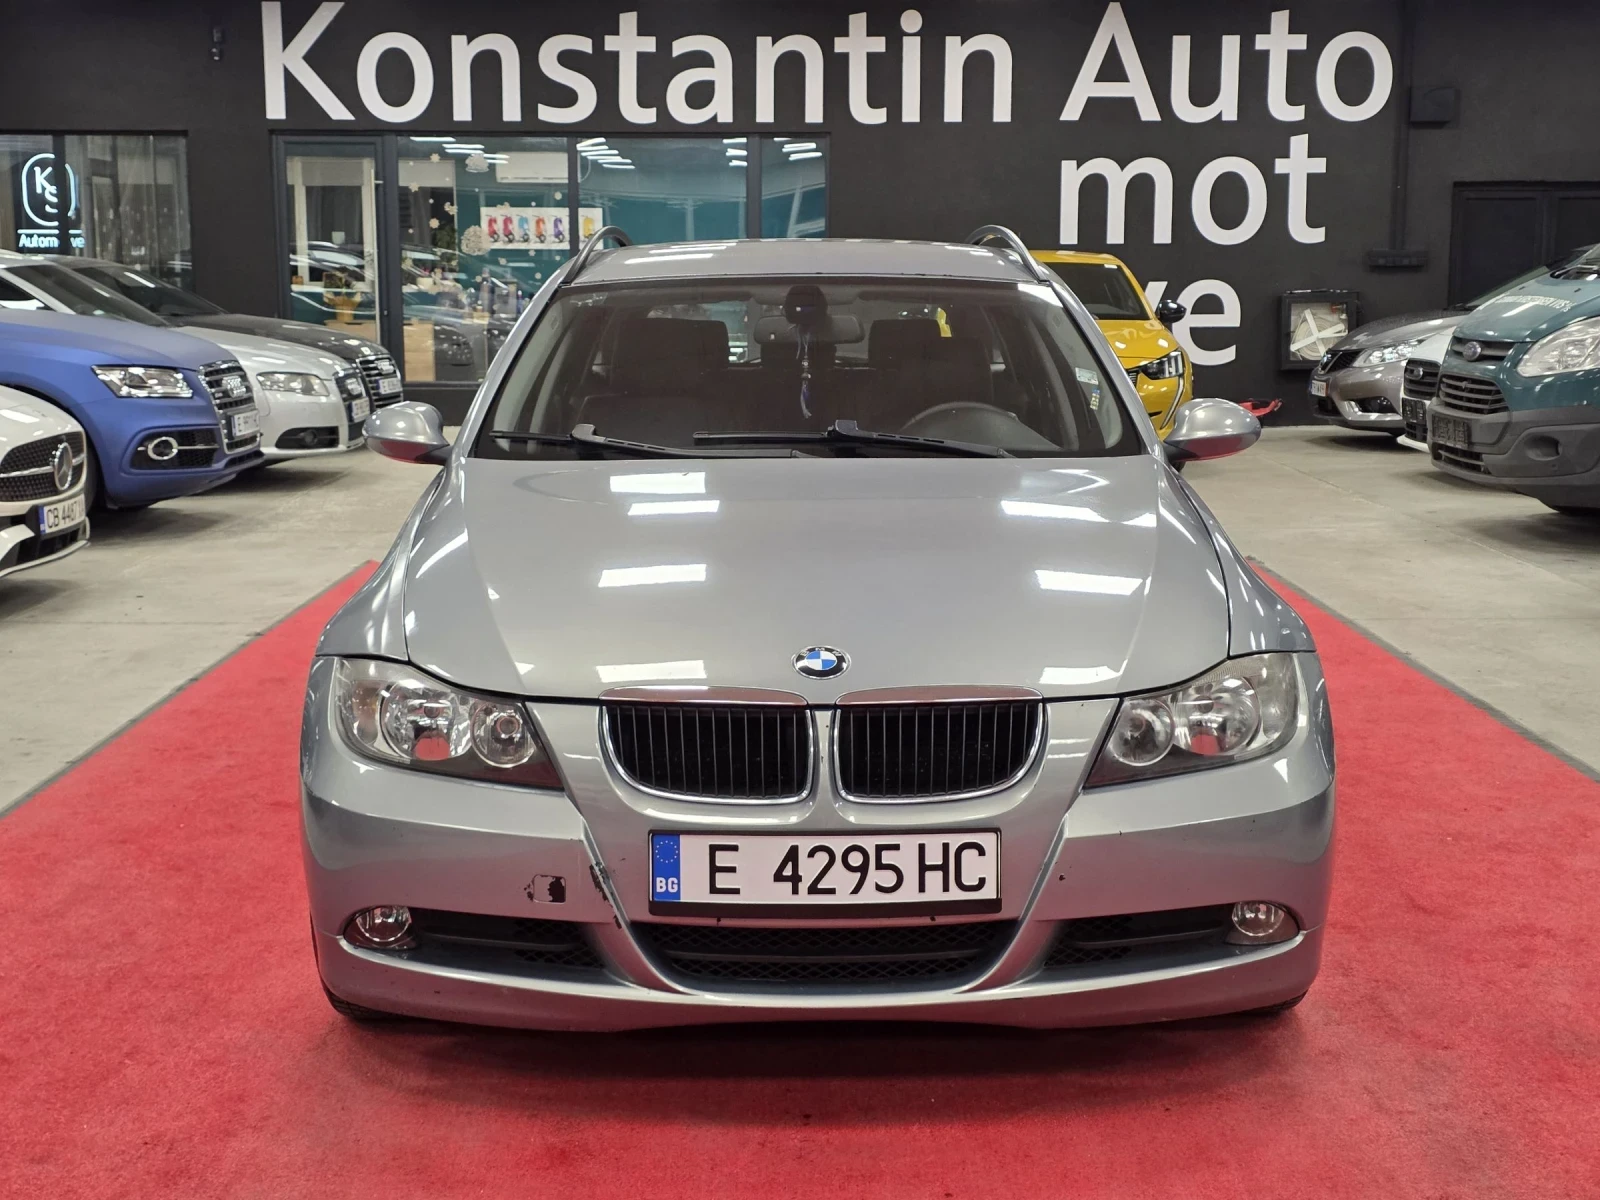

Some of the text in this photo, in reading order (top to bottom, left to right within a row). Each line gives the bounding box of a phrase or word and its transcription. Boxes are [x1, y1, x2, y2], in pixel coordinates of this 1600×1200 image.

[262, 1, 1393, 125] Konstantin Auto
[1059, 133, 1327, 246] mot
[656, 877, 679, 893] BG
[708, 841, 987, 896] E 4295 HC
